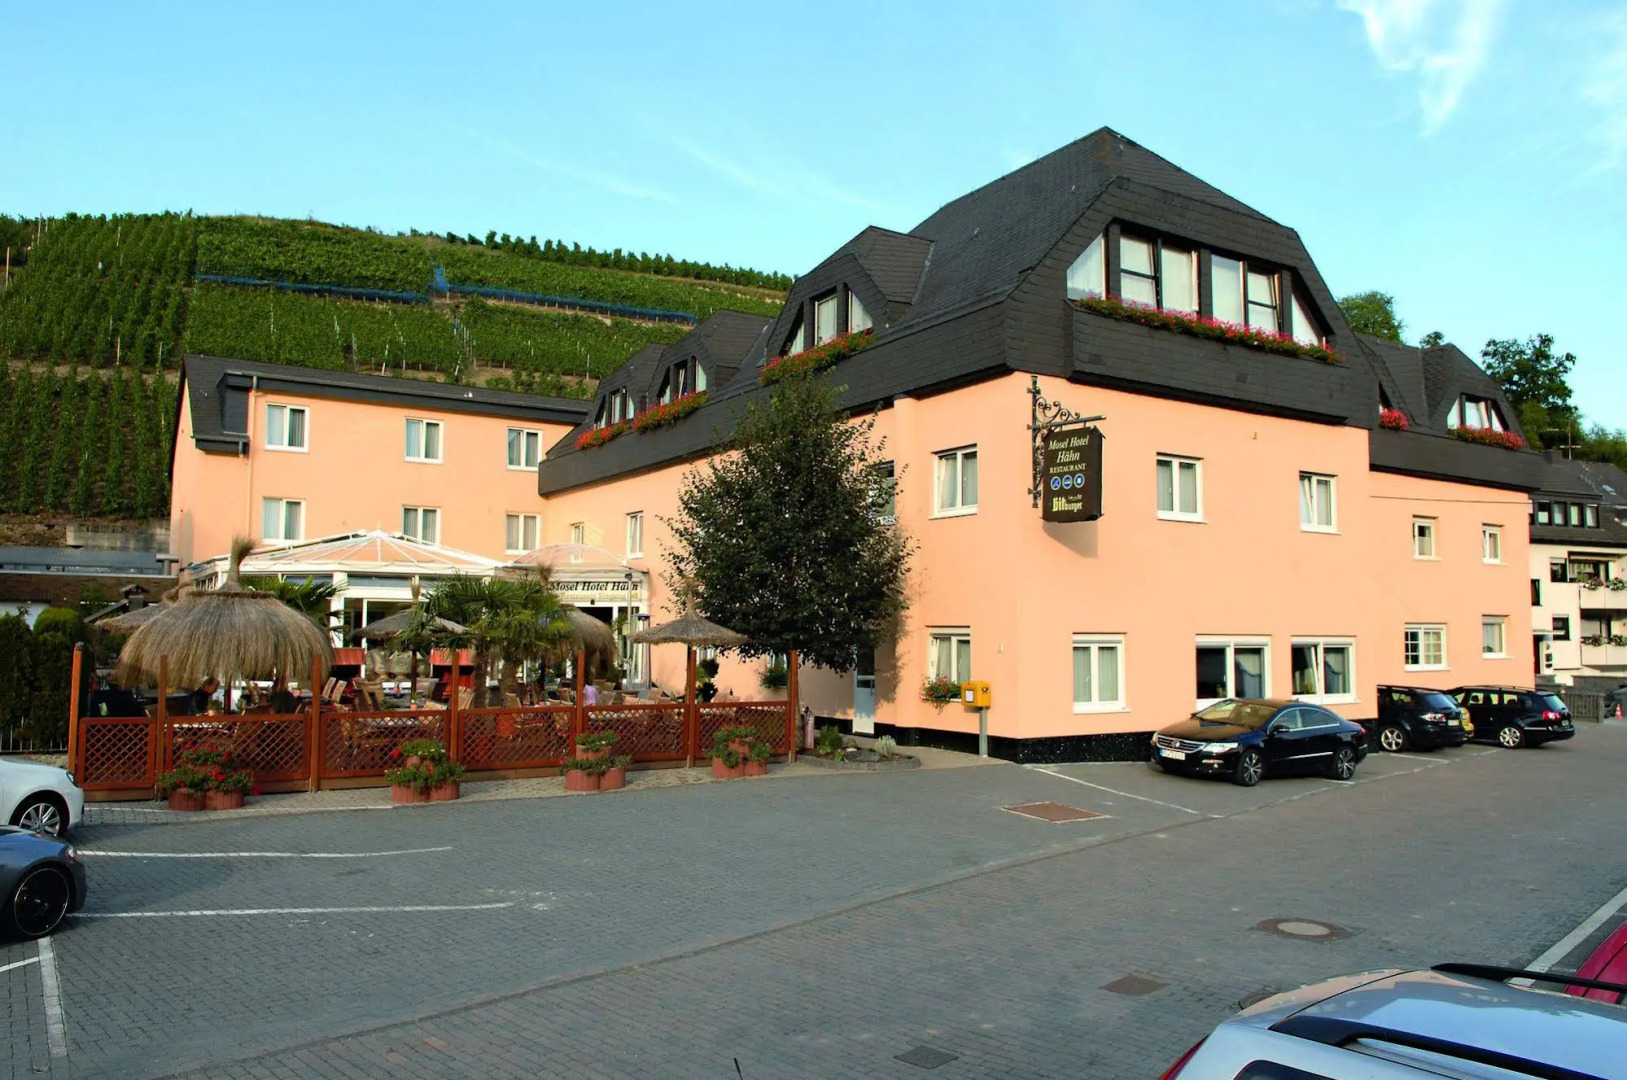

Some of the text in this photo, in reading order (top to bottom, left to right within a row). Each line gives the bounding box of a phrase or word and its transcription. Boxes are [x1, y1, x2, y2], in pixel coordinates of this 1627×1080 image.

[1048, 435, 1090, 450] Mosel Hotel
[1056, 450, 1080, 463] Hähn
[1050, 463, 1086, 474] RESTAURANT
[548, 581, 579, 591] Mosel
[581, 581, 608, 591] Hotel
